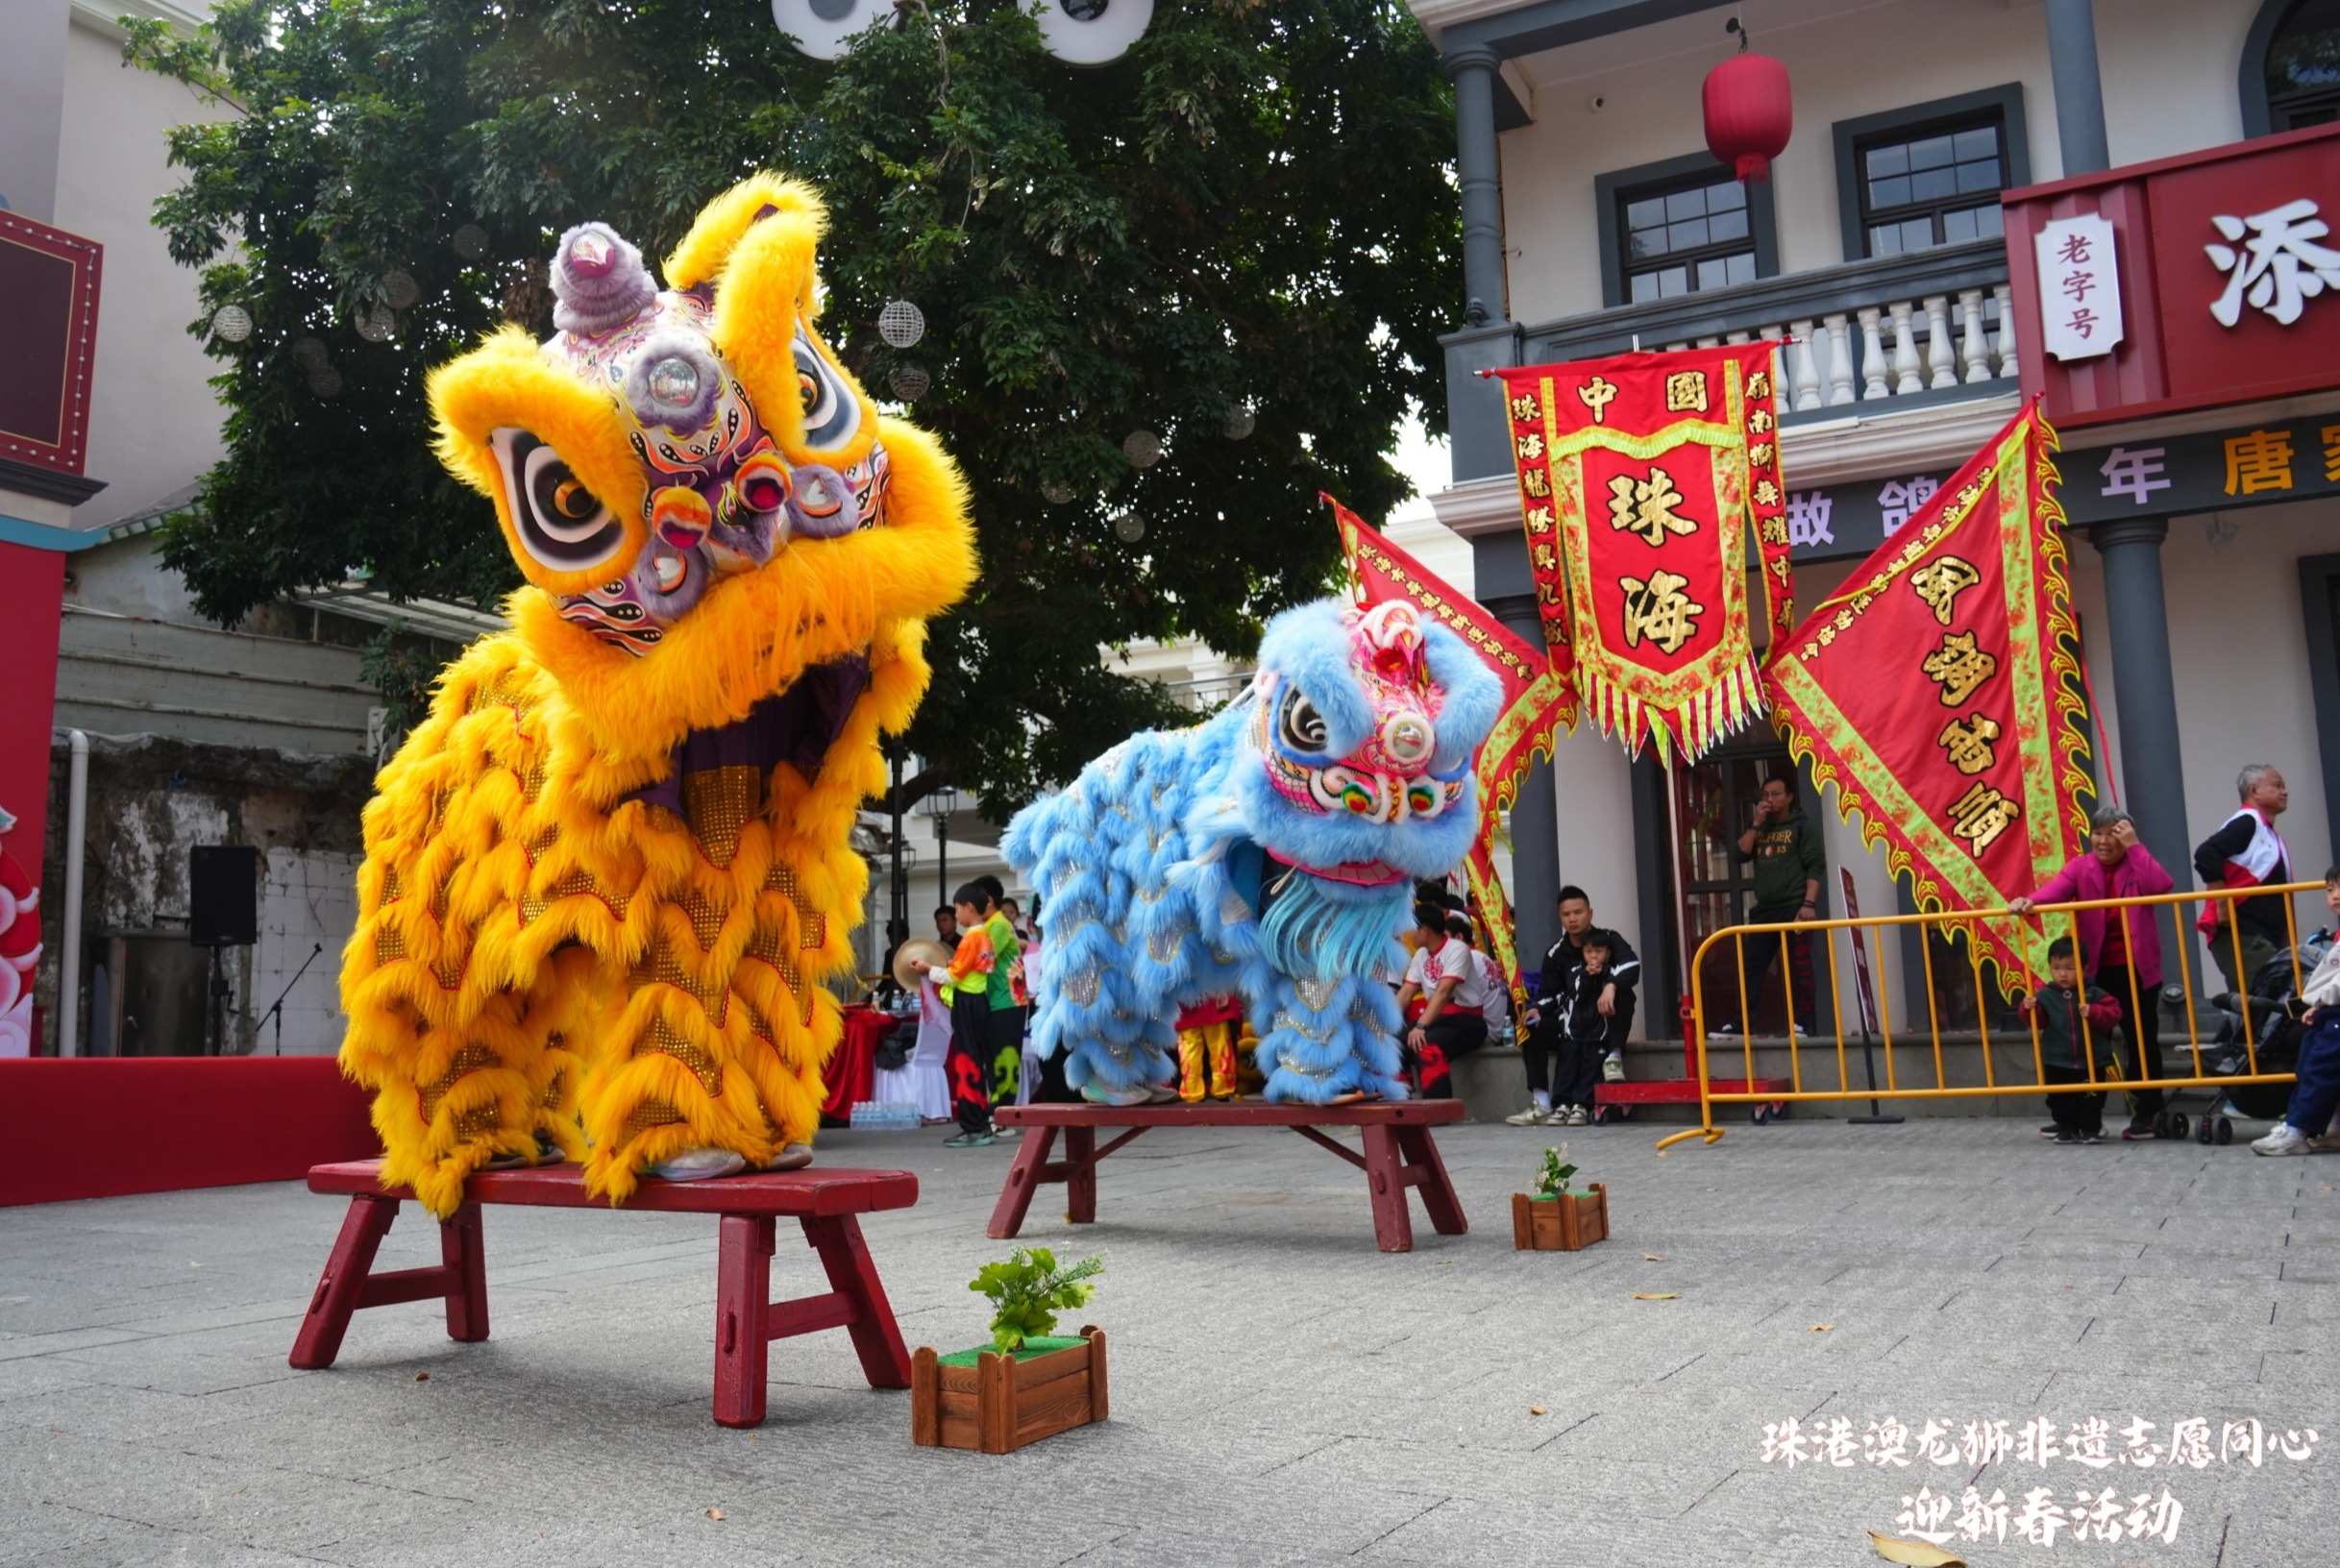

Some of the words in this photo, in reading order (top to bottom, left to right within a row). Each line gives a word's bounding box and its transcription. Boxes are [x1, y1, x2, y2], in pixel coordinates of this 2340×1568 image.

[2057, 233, 2100, 339] 老字号
[2204, 198, 2340, 329] 添
[1578, 370, 1710, 423] 中國
[1606, 467, 1704, 654] 珠海
[1909, 555, 2021, 859] 風調雨順
